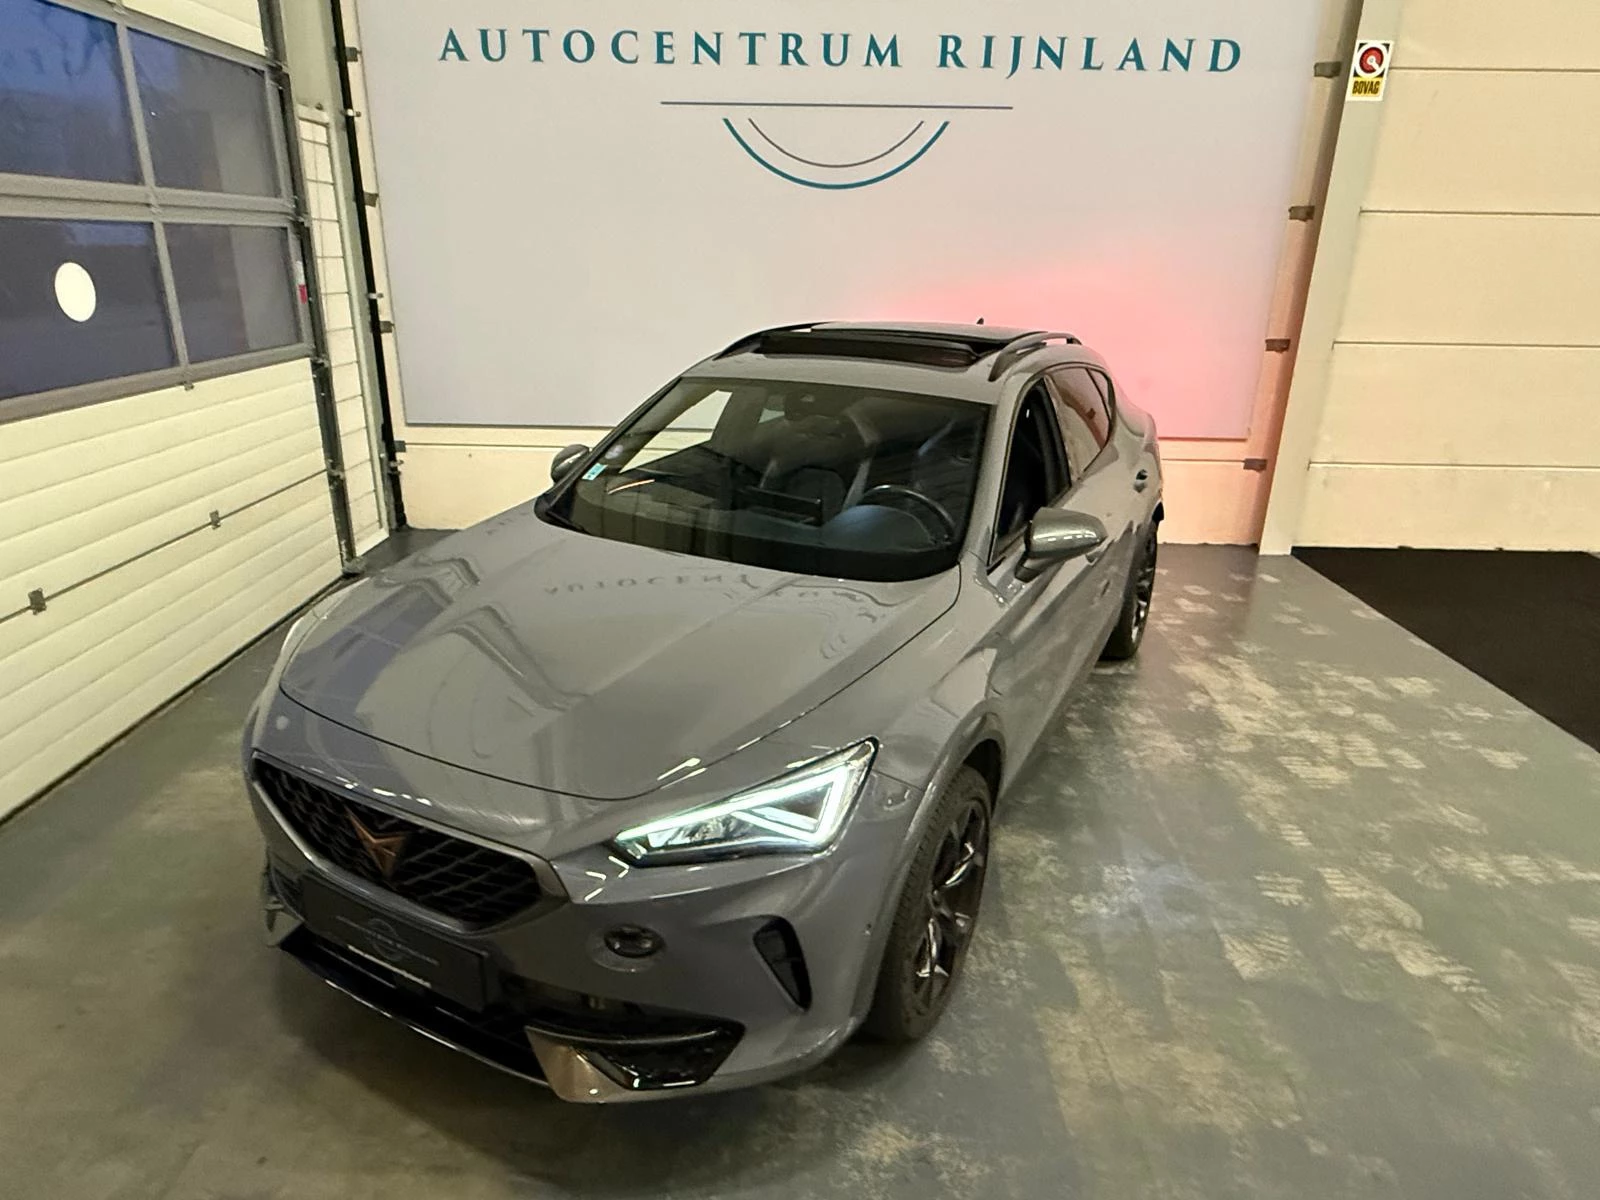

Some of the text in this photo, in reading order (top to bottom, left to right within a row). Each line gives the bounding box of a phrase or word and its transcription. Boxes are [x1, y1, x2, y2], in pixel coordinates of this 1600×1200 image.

[438, 27, 1242, 79] AUTOCENTRUM RIJNLAND
[1352, 80, 1381, 95] BOVAG
